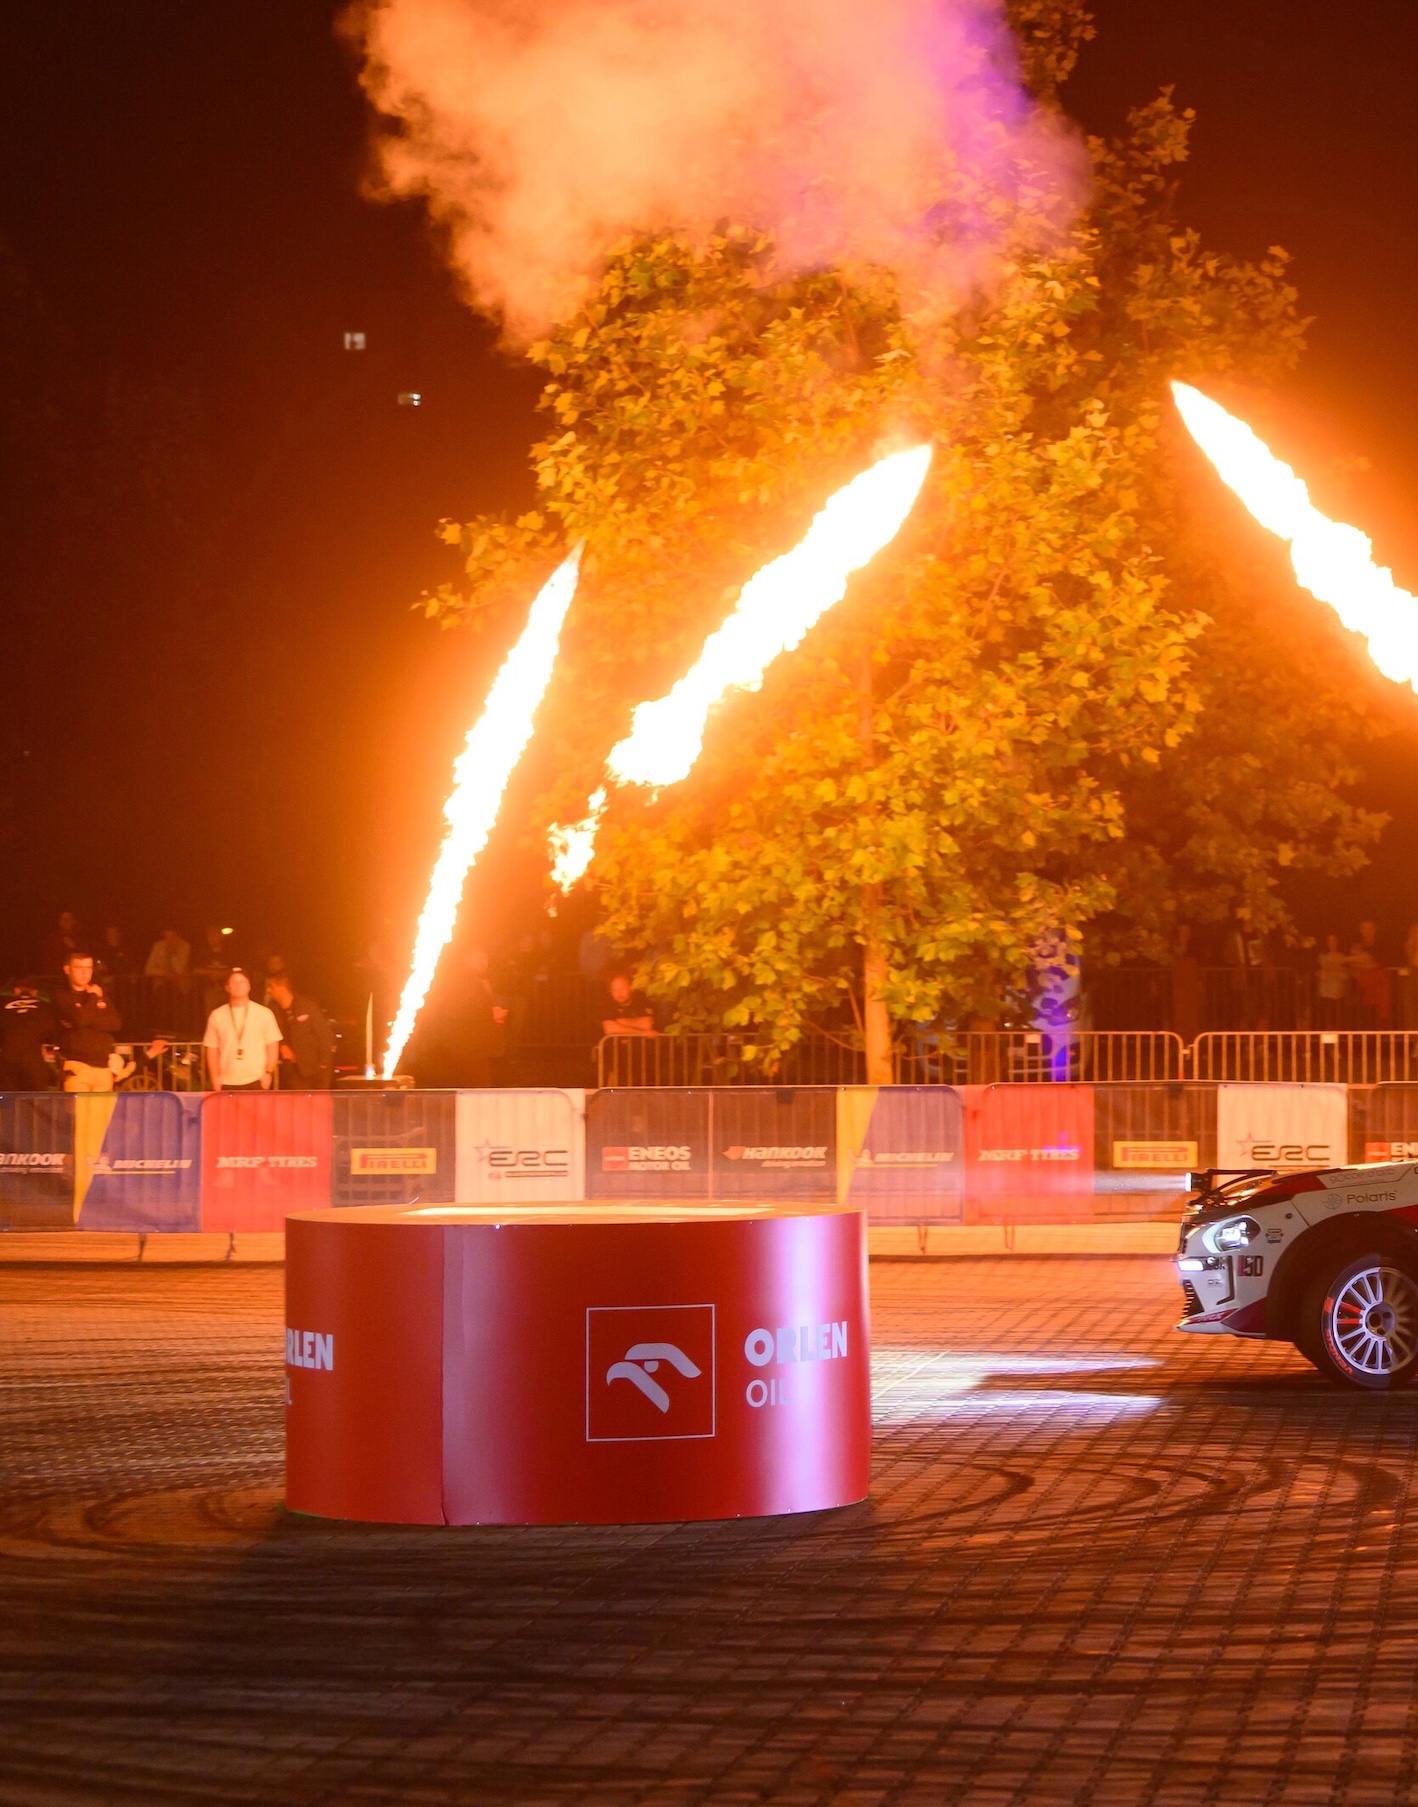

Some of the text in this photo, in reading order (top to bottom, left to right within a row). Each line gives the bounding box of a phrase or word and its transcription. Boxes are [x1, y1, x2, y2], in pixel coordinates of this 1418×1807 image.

[628, 1146, 692, 1160] ENEOS
[874, 1152, 954, 1162] MICHELIN
[1031, 1149, 1080, 1161] TYRES
[1121, 1146, 1190, 1162] PIRELLI
[112, 1159, 193, 1169] MICHELIN
[268, 1156, 318, 1168] TYRES
[360, 1153, 427, 1169] PIRELLI
[1346, 1190, 1397, 1205] Polaris
[744, 1320, 848, 1368] ORLEN
[745, 1378, 793, 1408] OIL
